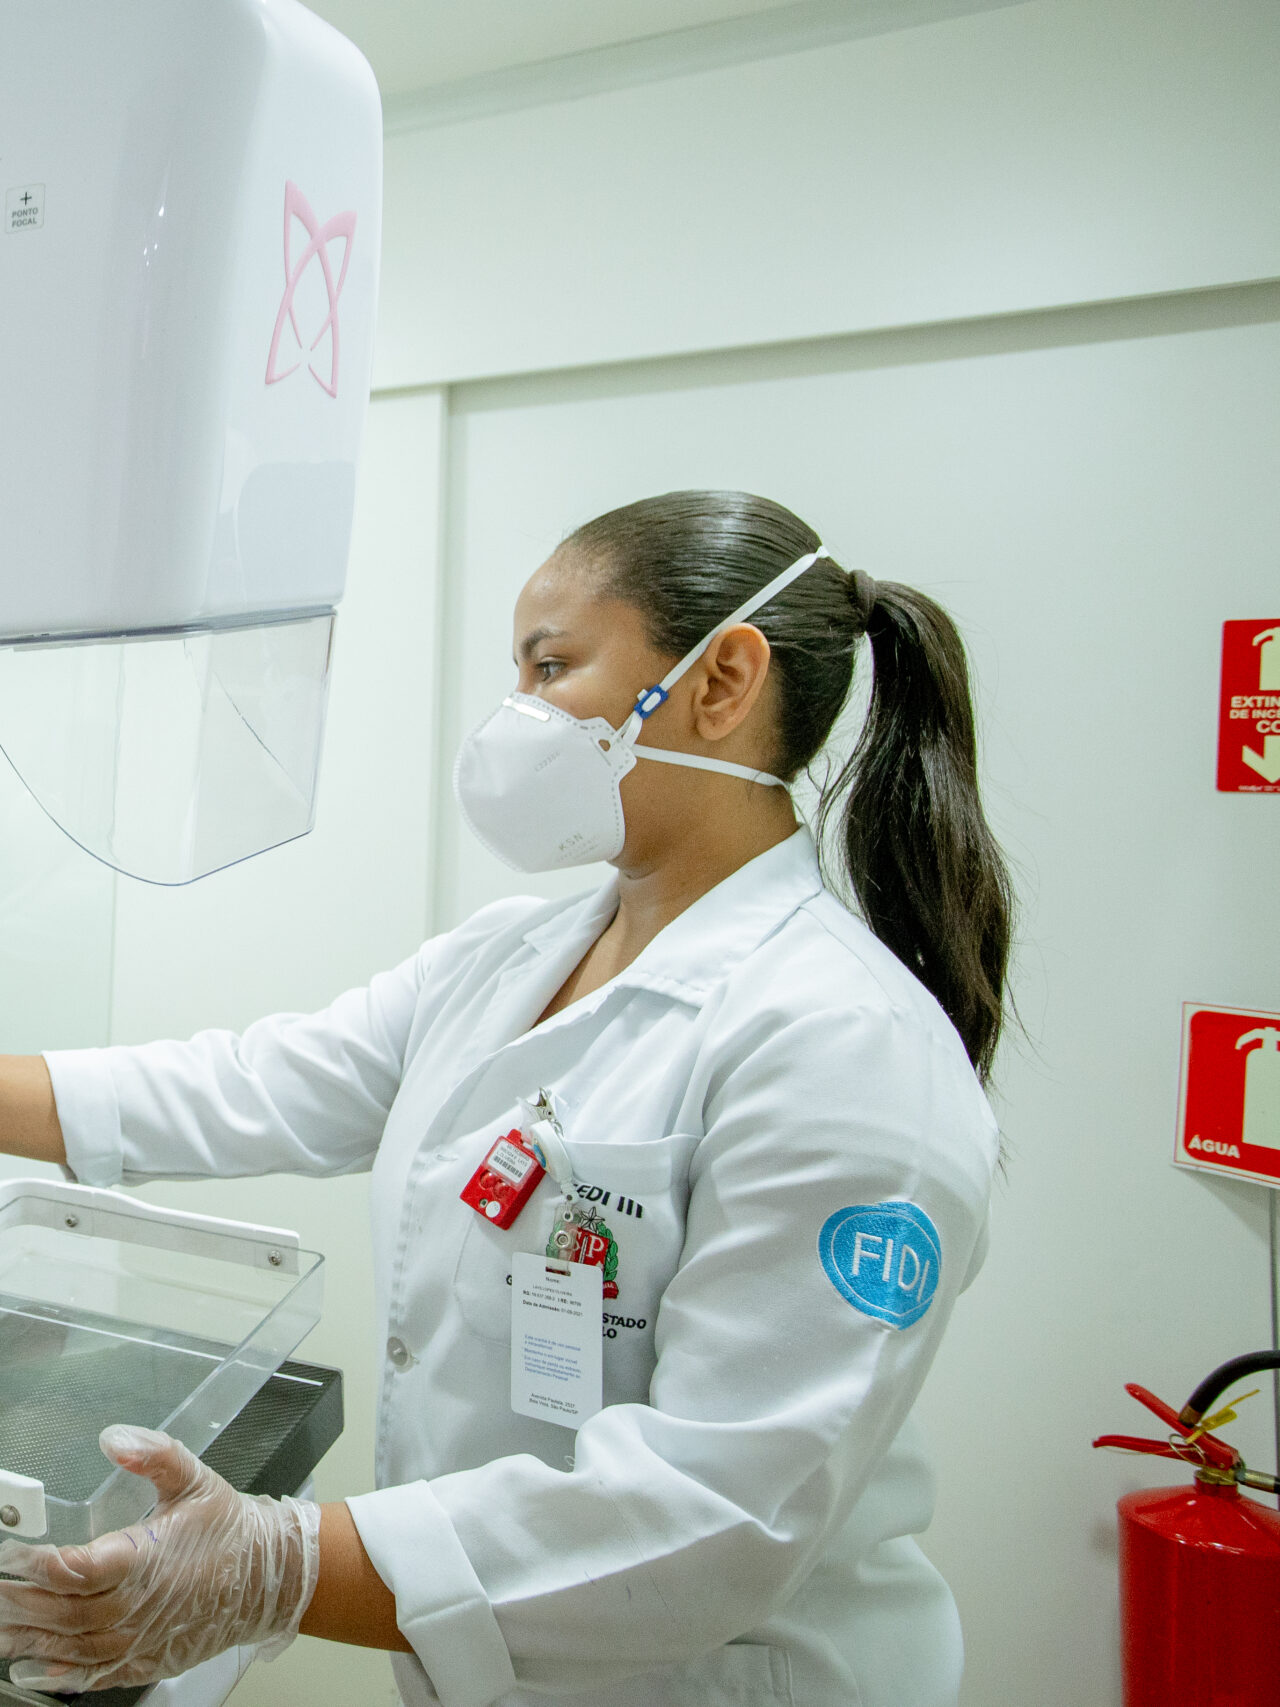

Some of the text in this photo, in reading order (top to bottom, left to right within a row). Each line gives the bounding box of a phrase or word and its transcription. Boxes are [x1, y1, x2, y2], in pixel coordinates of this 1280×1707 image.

[11, 207, 39, 218] PONTO
[11, 217, 38, 228] FOCAL
[1231, 695, 1280, 708] EXTIN
[1229, 709, 1249, 719] DE
[1188, 1134, 1241, 1159] ÁGUA
[573, 1181, 611, 1206] EDI
[851, 1231, 930, 1302] FIDI
[602, 1312, 647, 1329] STADO
